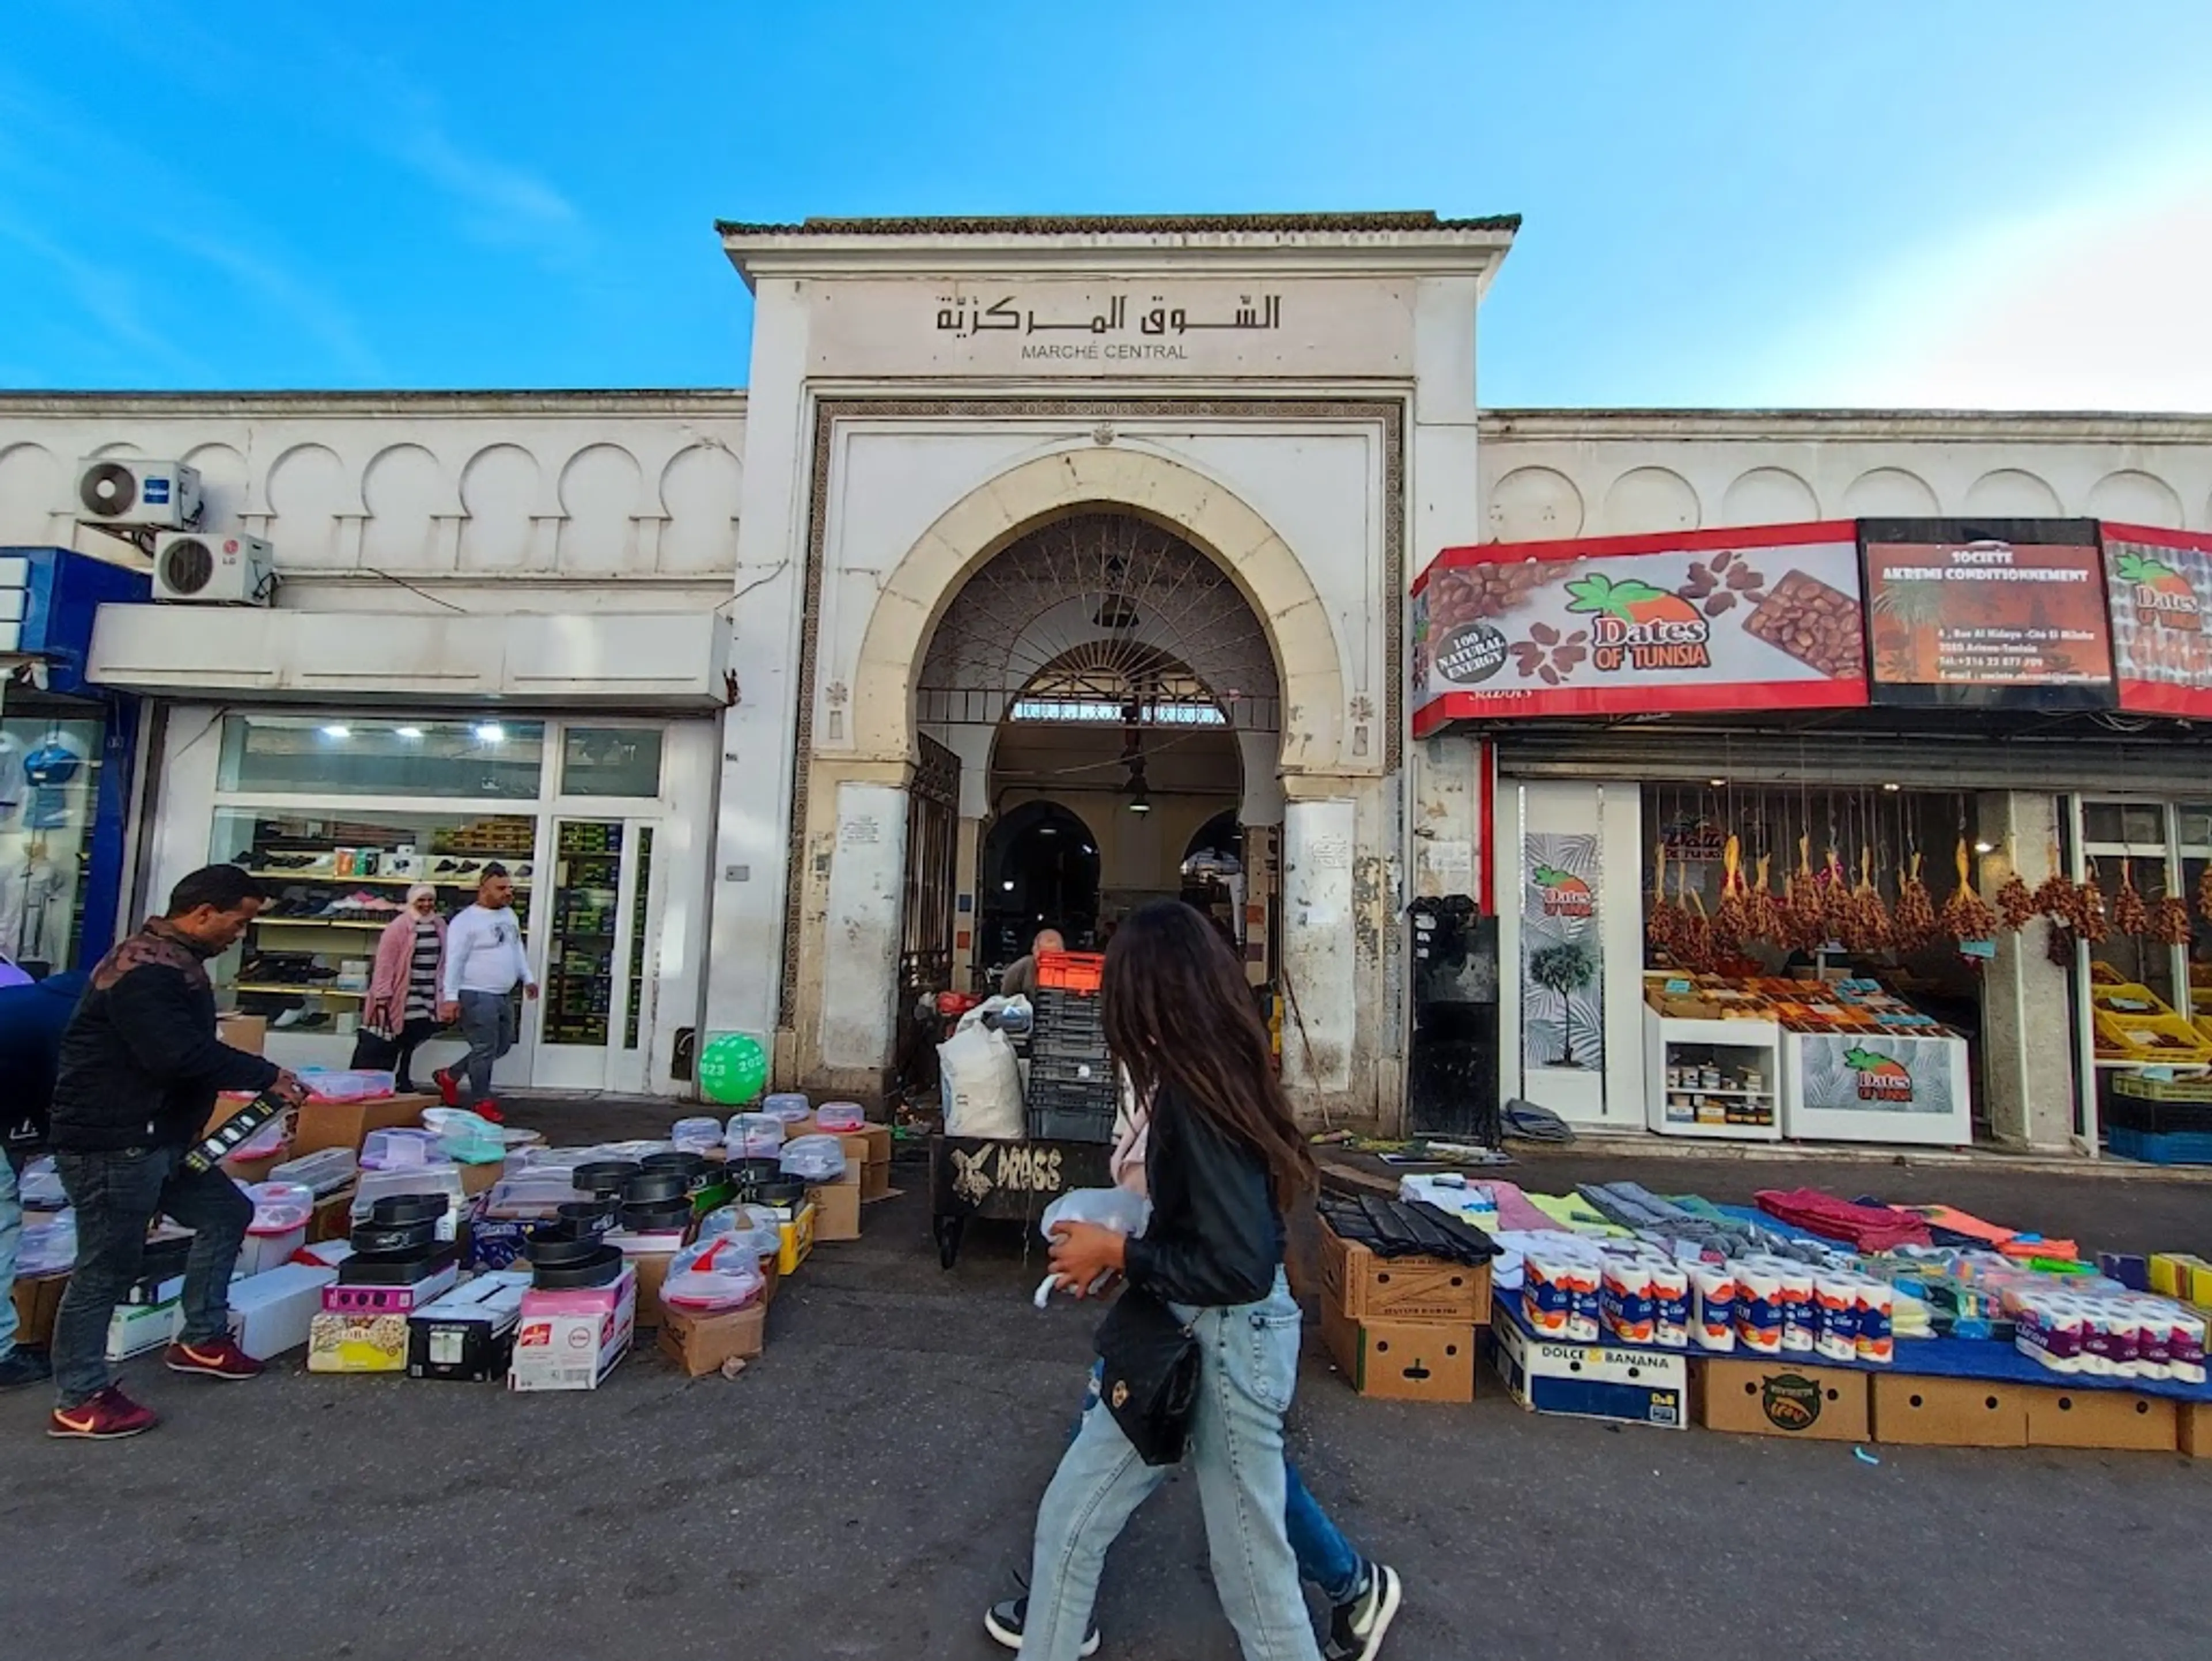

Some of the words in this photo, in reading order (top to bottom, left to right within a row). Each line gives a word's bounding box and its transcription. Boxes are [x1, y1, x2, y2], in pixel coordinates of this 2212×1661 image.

[1022, 341, 1099, 360] MARCHÉ
[1104, 344, 1188, 360] CENTRAL
[222, 557, 237, 565] LG
[1945, 568, 2089, 582] CONDITIONNEMENT
[1453, 632, 1479, 650] 100
[1594, 617, 1707, 646] Dates
[1438, 636, 1505, 669] NATURAL
[1596, 647, 1623, 668] OF
[1633, 644, 1708, 668] TUNISIA
[1447, 650, 1503, 679] ENERGY
[1858, 1071, 1911, 1089] Dates
[1541, 1346, 1585, 1360] DOLCE
[1588, 1347, 1602, 1363] &
[1605, 1352, 1669, 1369] BANANA
